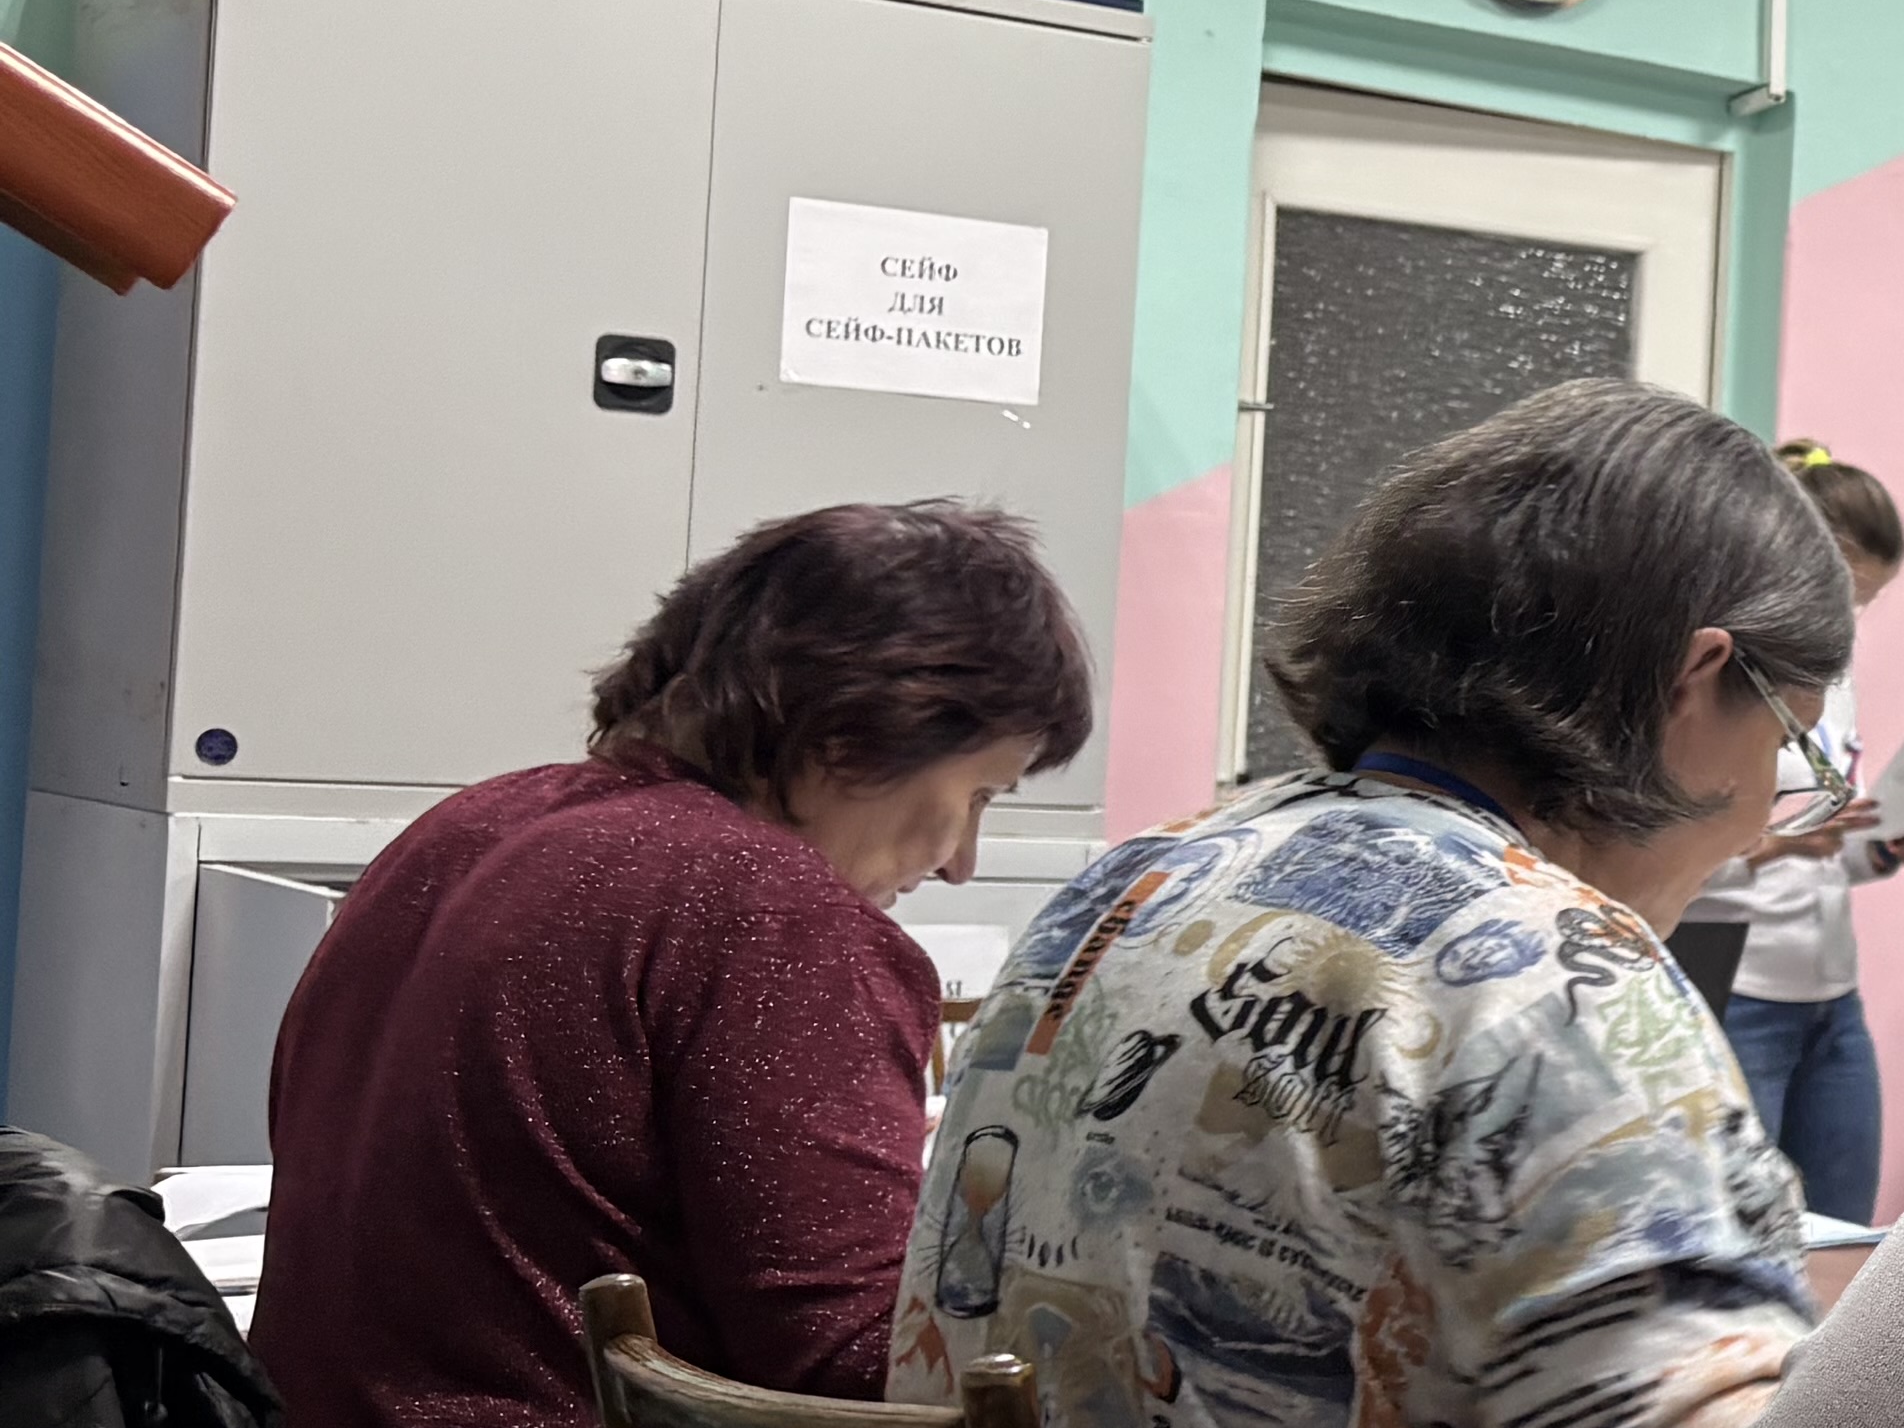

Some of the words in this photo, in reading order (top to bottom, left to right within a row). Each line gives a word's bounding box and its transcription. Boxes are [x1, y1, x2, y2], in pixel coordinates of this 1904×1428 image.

[881, 255, 959, 283] СЕЙФ
[887, 291, 945, 317] ДЛЯ
[805, 317, 1023, 359] СЕЙФ-ПАКЕТОВ
